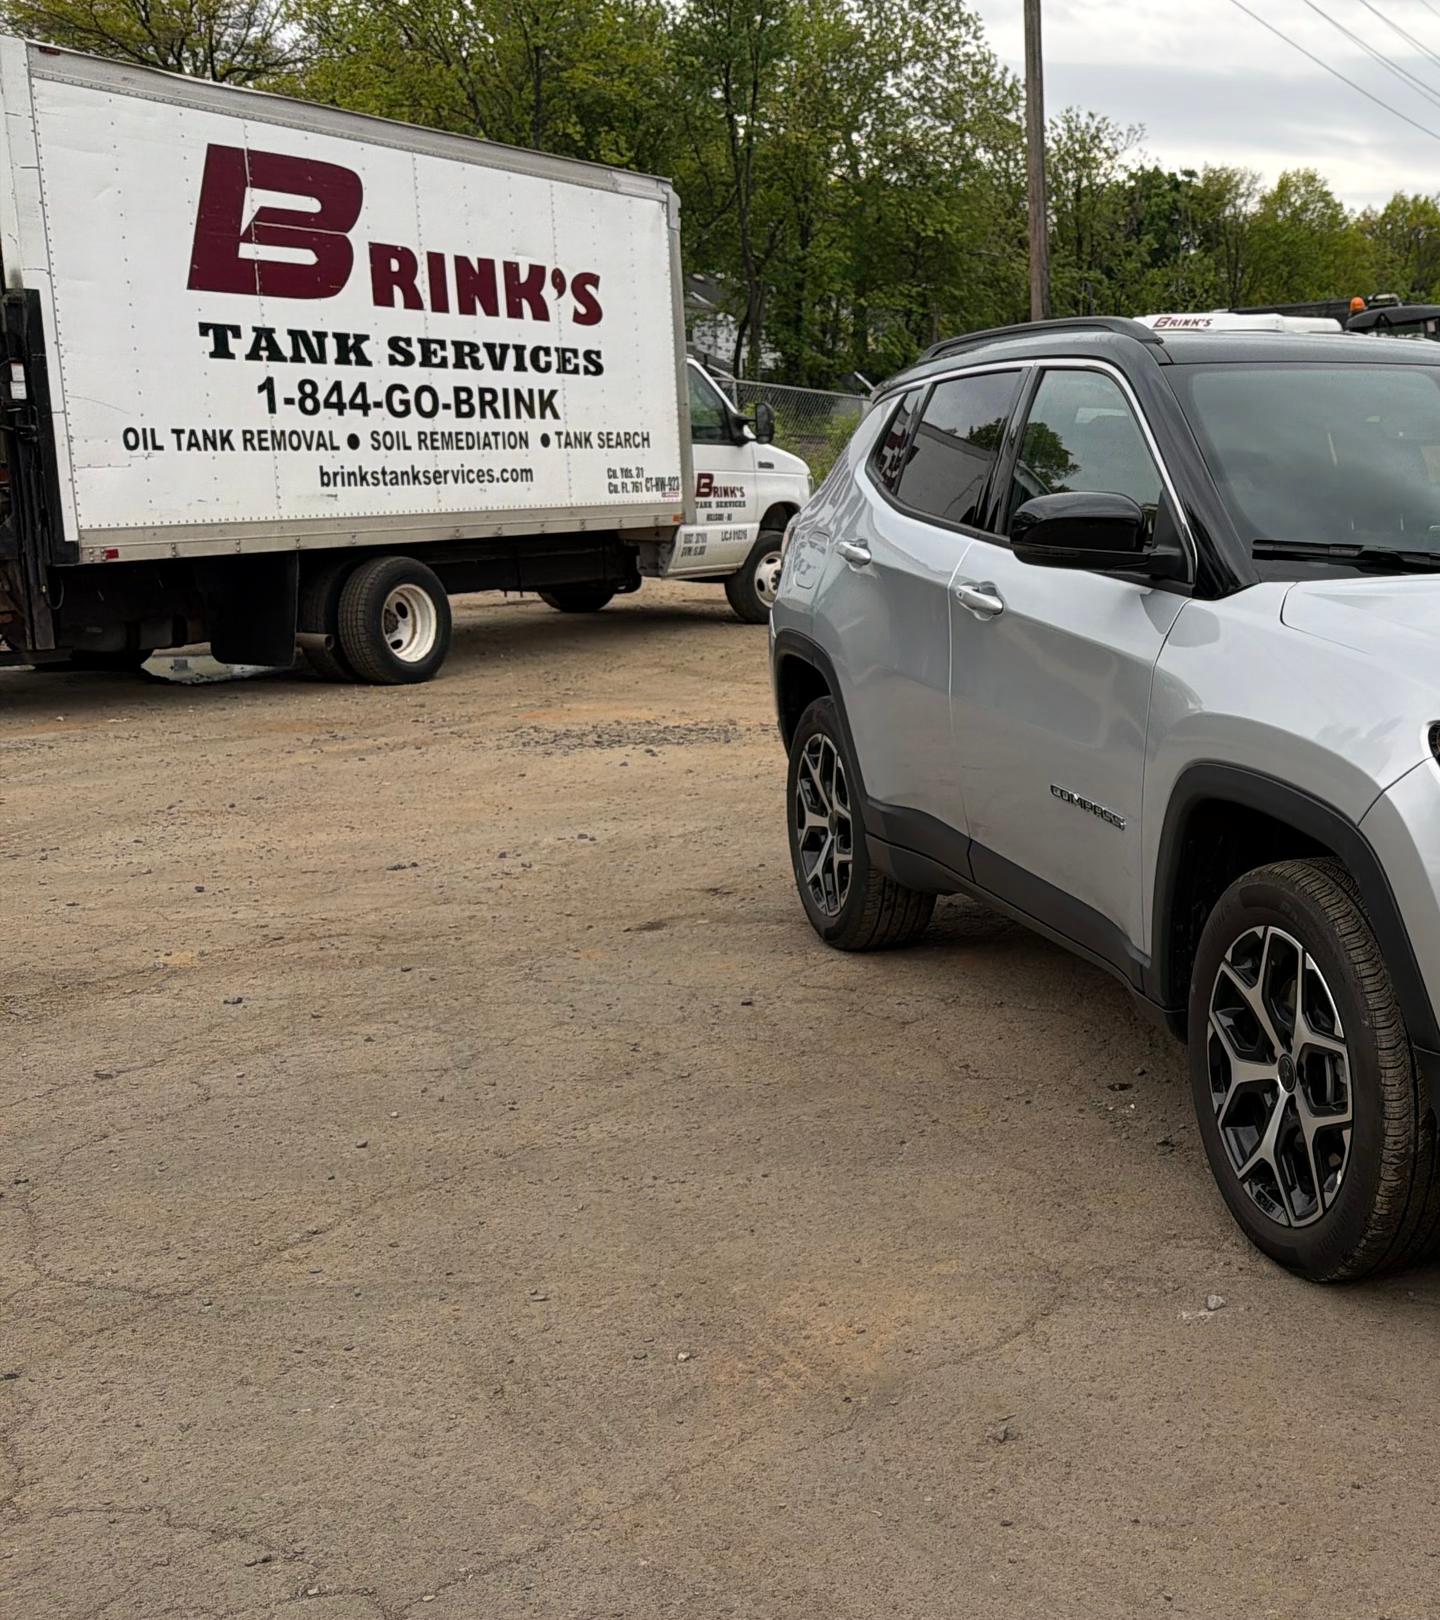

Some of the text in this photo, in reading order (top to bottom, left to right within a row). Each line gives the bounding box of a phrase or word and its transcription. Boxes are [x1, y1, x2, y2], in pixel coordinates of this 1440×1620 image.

[187, 143, 603, 326] BRINK'S
[1153, 316, 1213, 328] BRINK'S
[198, 321, 604, 377] TANK SERVICES
[257, 376, 561, 420] 1-844-GO-BRINK
[122, 427, 651, 451] OIL TANK REMOVAL SOIL REMEDIATION TANK SEARCH
[319, 464, 534, 487] brinkstankservices.com
[696, 473, 745, 498] BRINK'S
[716, 500, 746, 508] SERVICES
[1050, 784, 1126, 831] COMPASS
